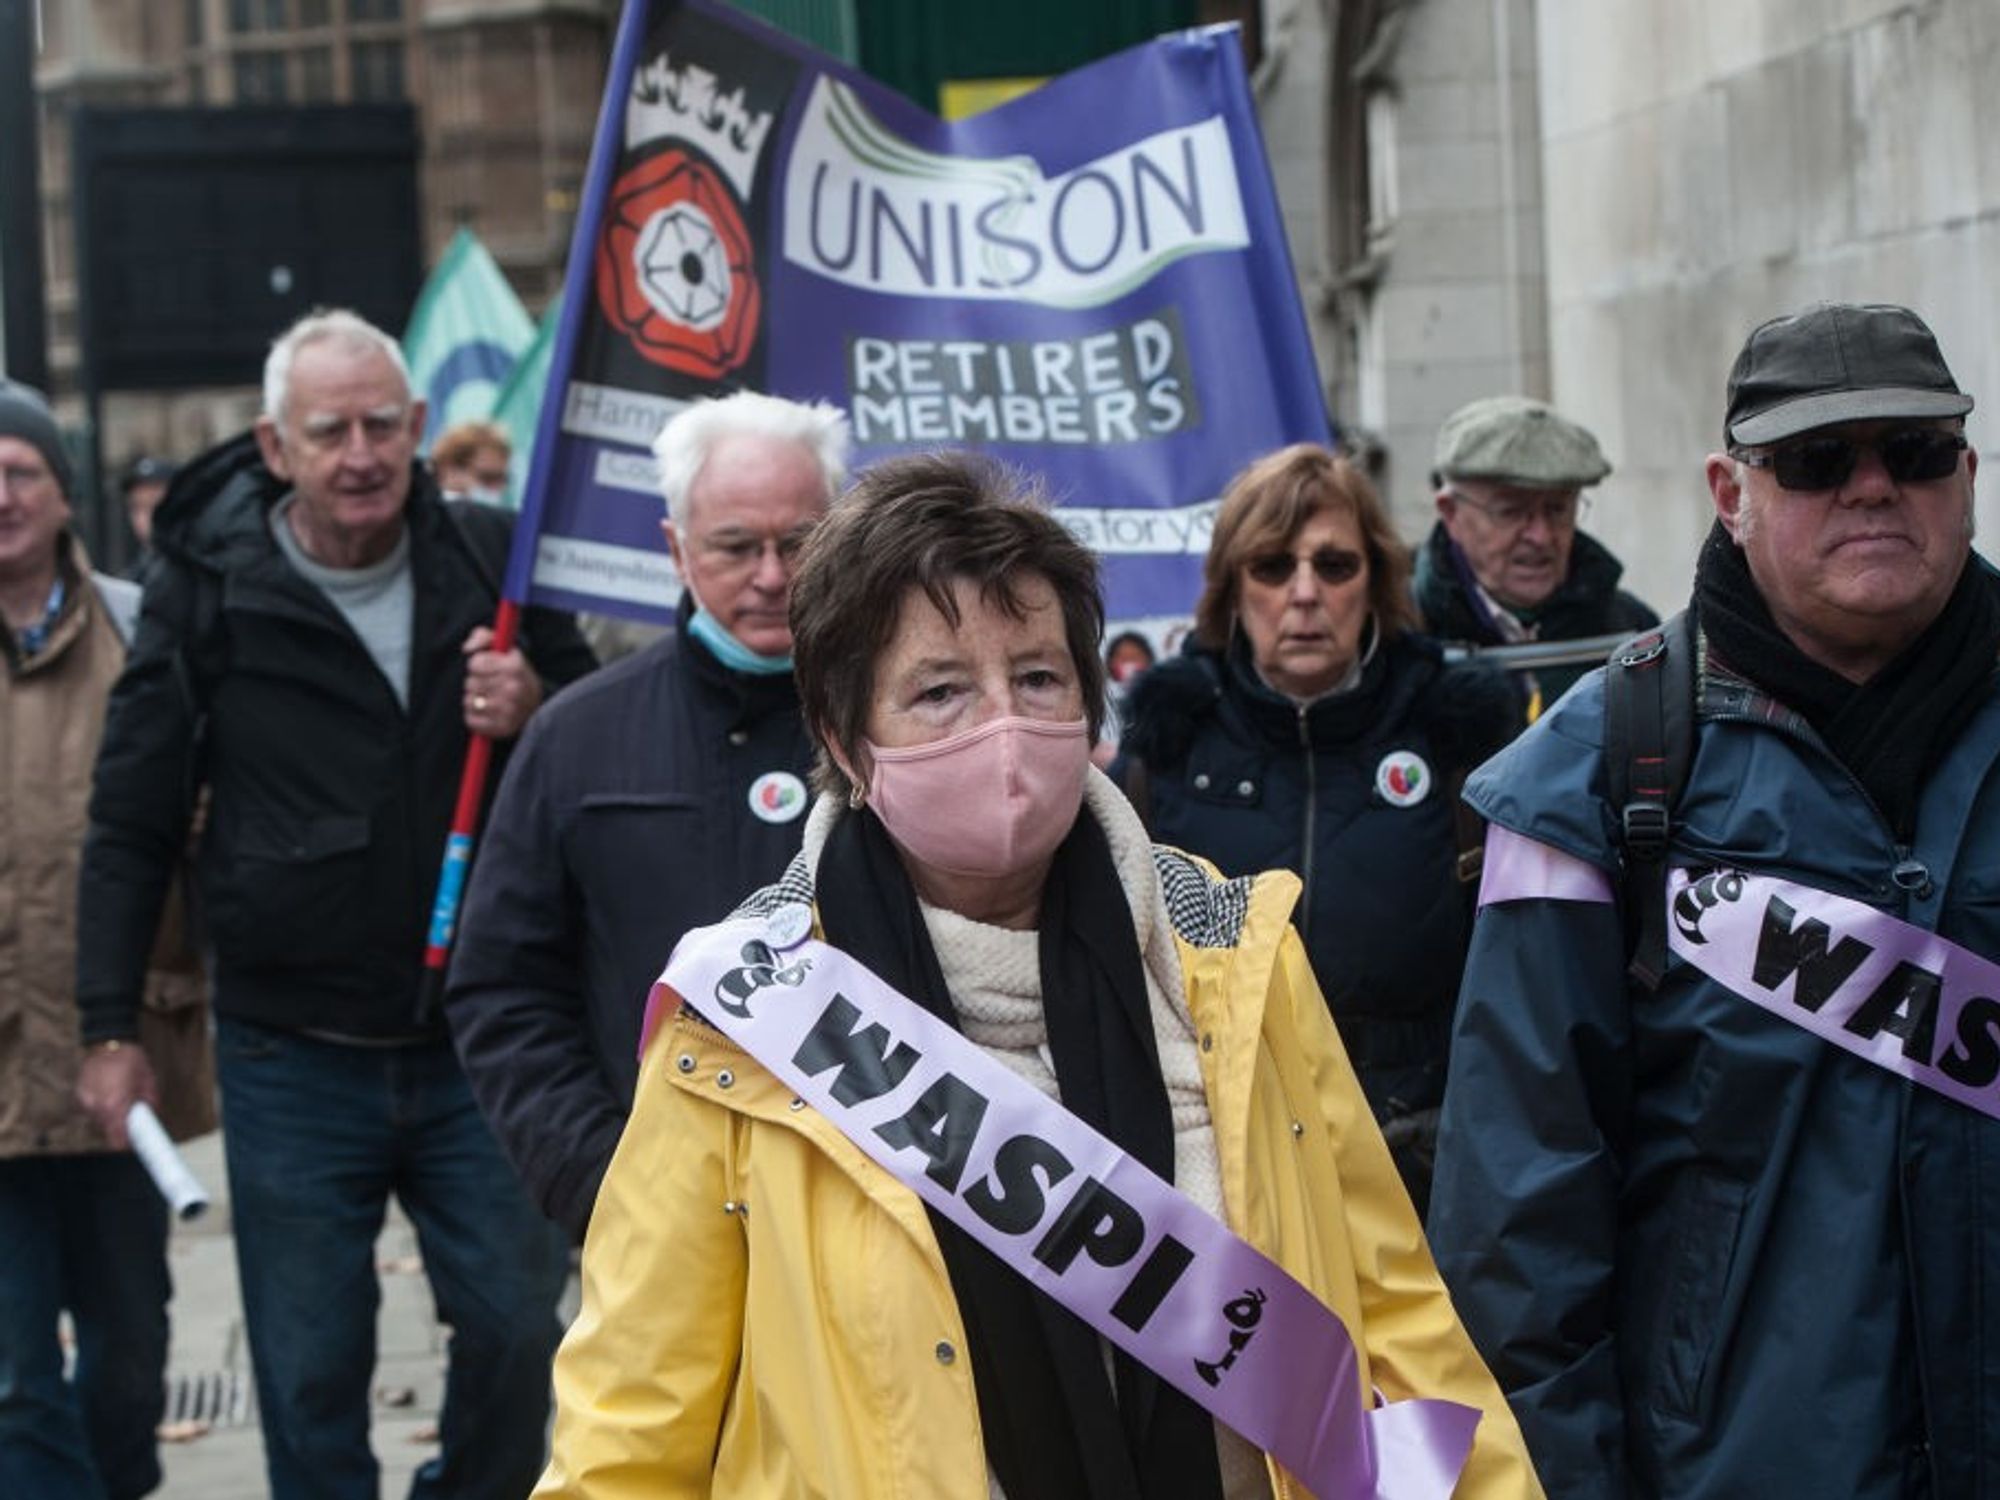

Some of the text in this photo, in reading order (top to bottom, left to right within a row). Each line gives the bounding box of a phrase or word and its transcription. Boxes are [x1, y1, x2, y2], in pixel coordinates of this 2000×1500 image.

[811, 136, 1205, 289] UNISON
[853, 319, 1173, 394] RETIRED
[854, 378, 1185, 443] MEMBERS
[1098, 508, 1156, 545] for
[791, 992, 1195, 1333] WASPI
